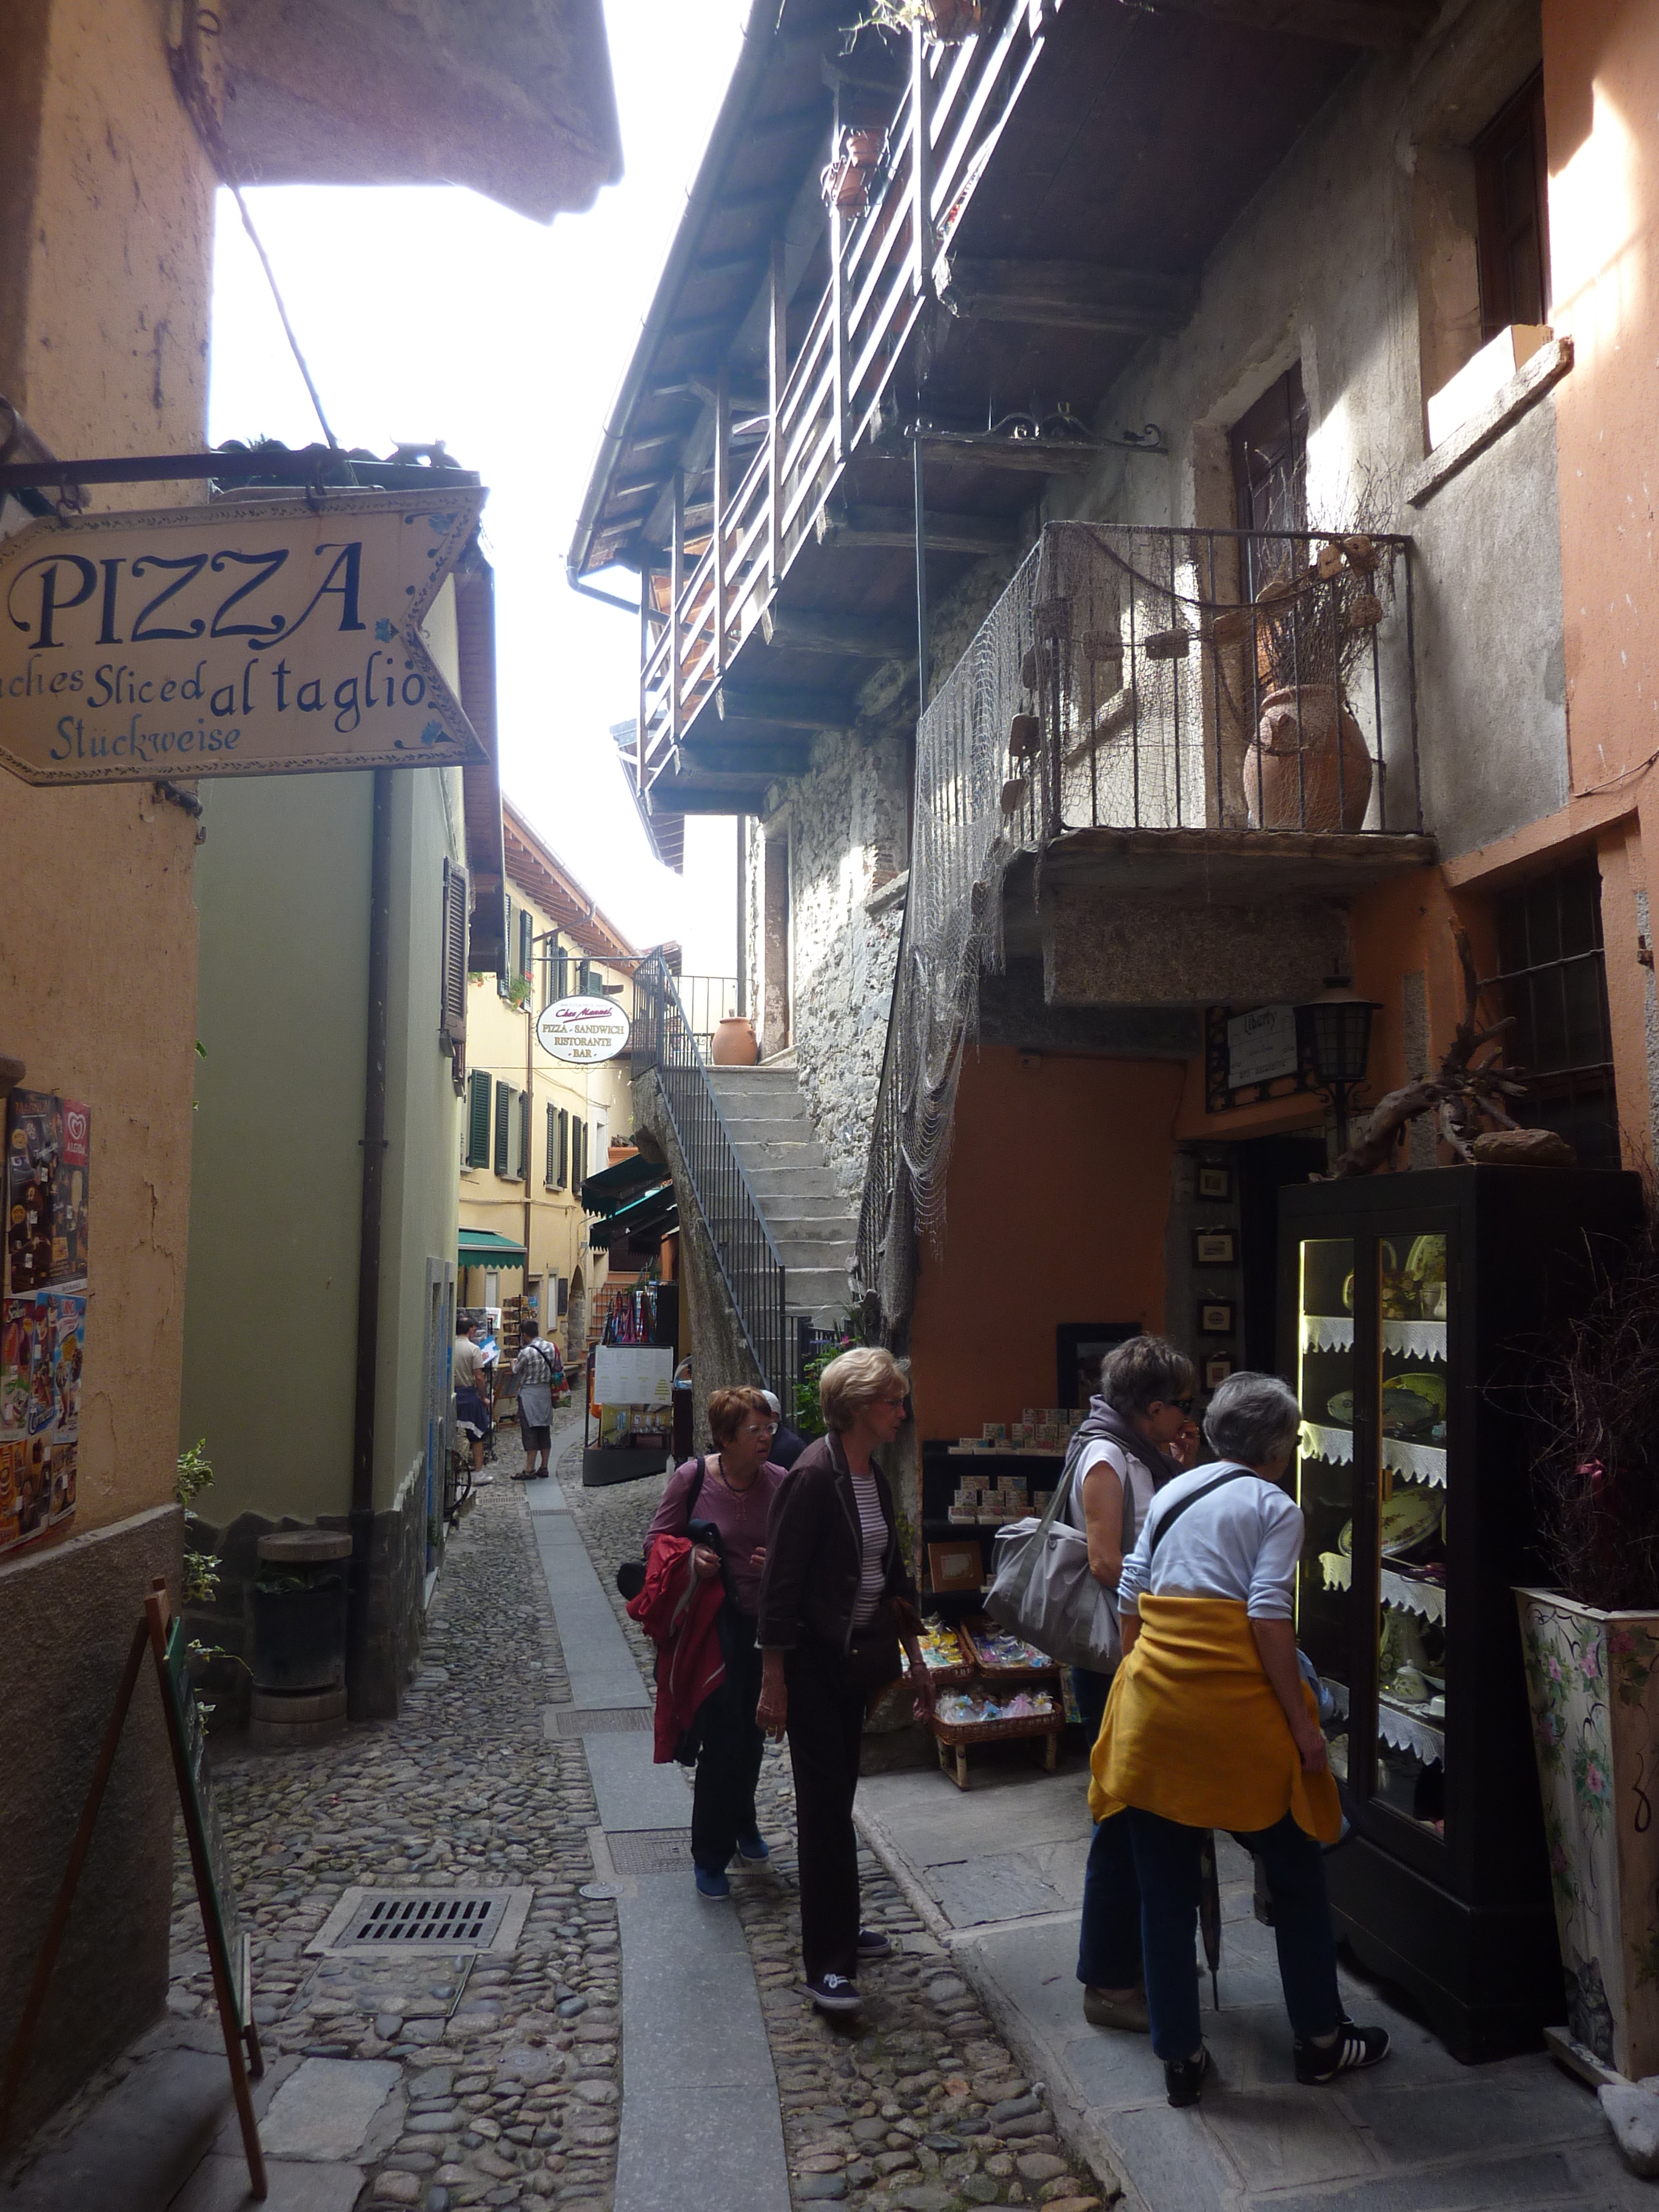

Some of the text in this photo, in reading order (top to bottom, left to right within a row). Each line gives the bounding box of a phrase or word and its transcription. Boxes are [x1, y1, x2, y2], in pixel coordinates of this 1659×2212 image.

[7, 541, 366, 651] PIZZA
[0, 651, 426, 734] ches Sliced al taglio
[50, 714, 241, 762] Stückweise
[542, 1024, 568, 1033] PIZZA
[574, 1025, 625, 1034] SANDWICH
[554, 1037, 612, 1047] RISTORANTE
[573, 1049, 592, 1057] BAR
